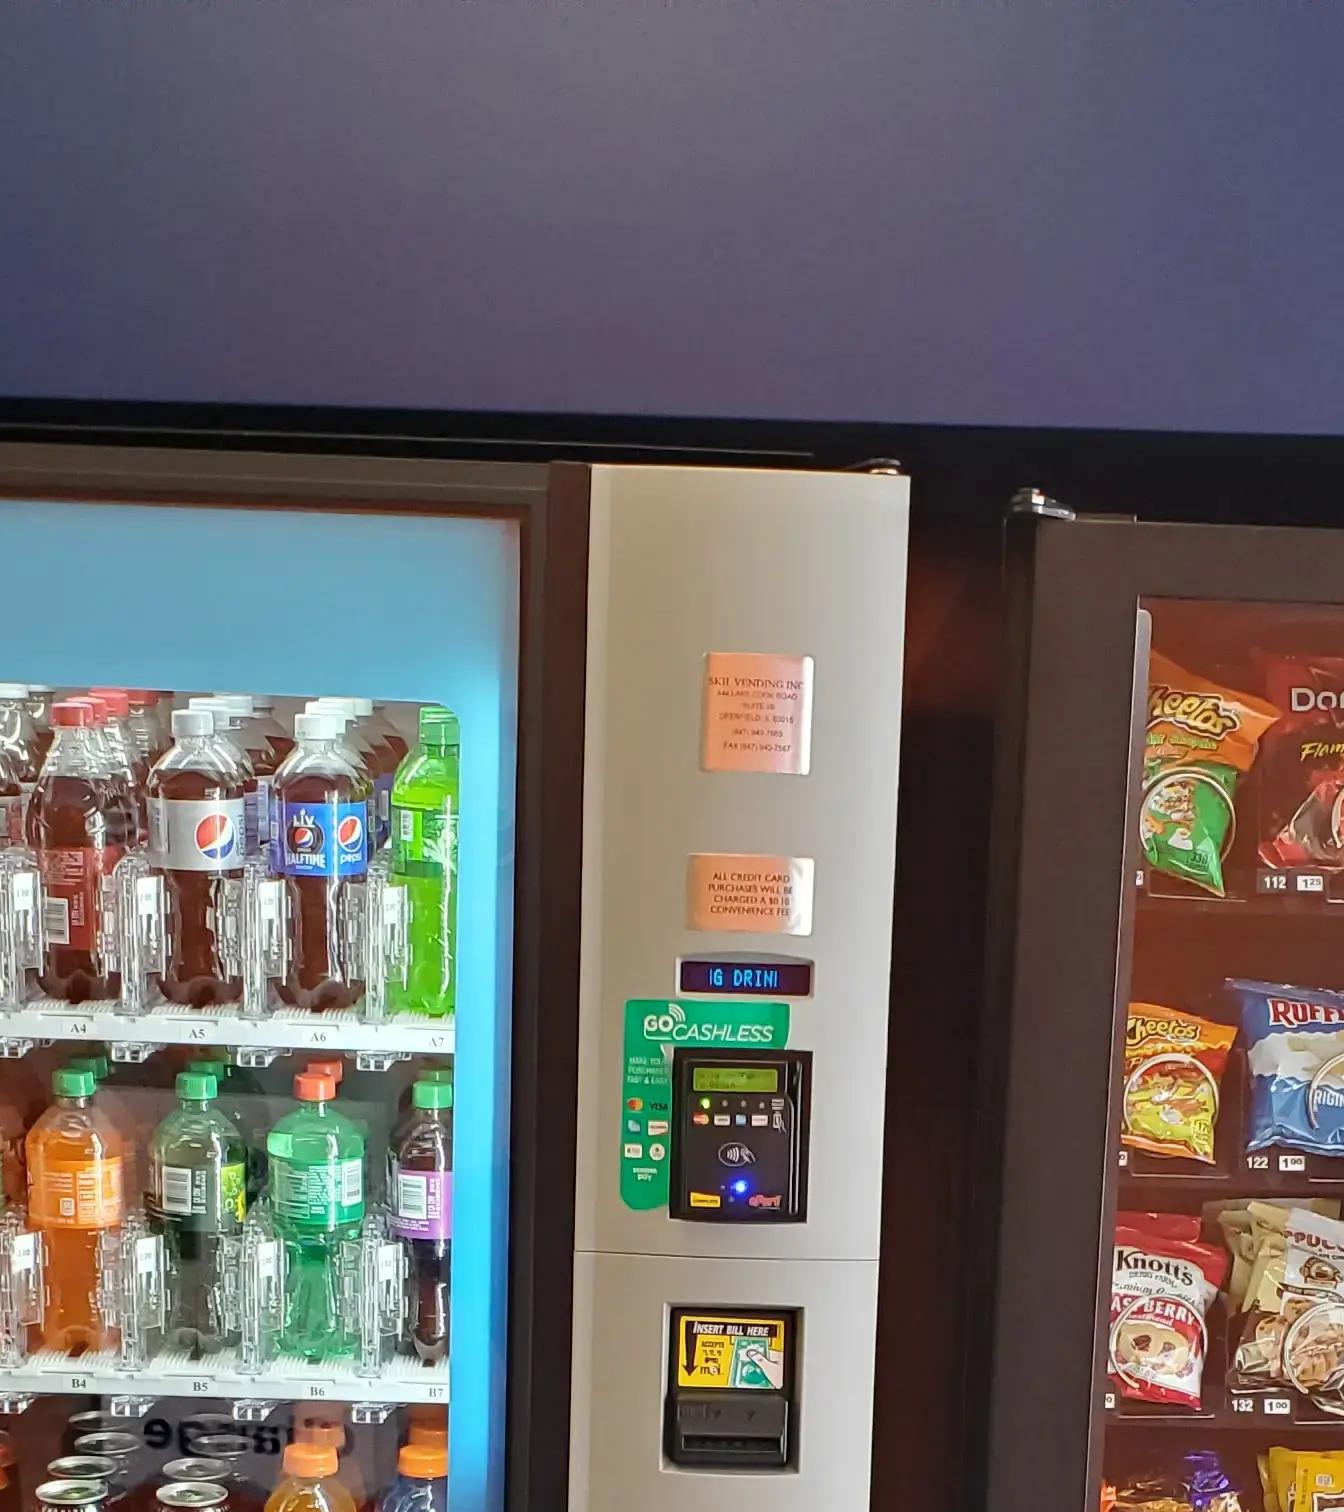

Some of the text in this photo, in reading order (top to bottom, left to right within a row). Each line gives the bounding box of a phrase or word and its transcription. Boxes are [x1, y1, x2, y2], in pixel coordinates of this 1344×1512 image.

[734, 678, 783, 689] VENDING
[340, 853, 362, 865] pepsi
[712, 873, 791, 883] ALL CREDIT CARD
[1263, 876, 1287, 889] 112
[708, 884, 780, 894] PURCHASES WILL
[713, 895, 766, 905] CHARGED A
[710, 905, 773, 916] CONVENIENCE
[70, 1022, 87, 1034] A4
[188, 1028, 206, 1039] A5
[643, 1014, 774, 1042] GO CASHLESS
[309, 1032, 327, 1043] A6
[428, 1036, 445, 1048] A7
[1247, 1156, 1269, 1169] 122
[1116, 1249, 1193, 1287] Knott's
[692, 1321, 770, 1336] INSERT BILL HERE
[71, 1378, 86, 1389] B4
[192, 1381, 209, 1392] B5
[309, 1385, 326, 1397] B6
[428, 1386, 444, 1398] B7
[1231, 1400, 1253, 1412] 132
